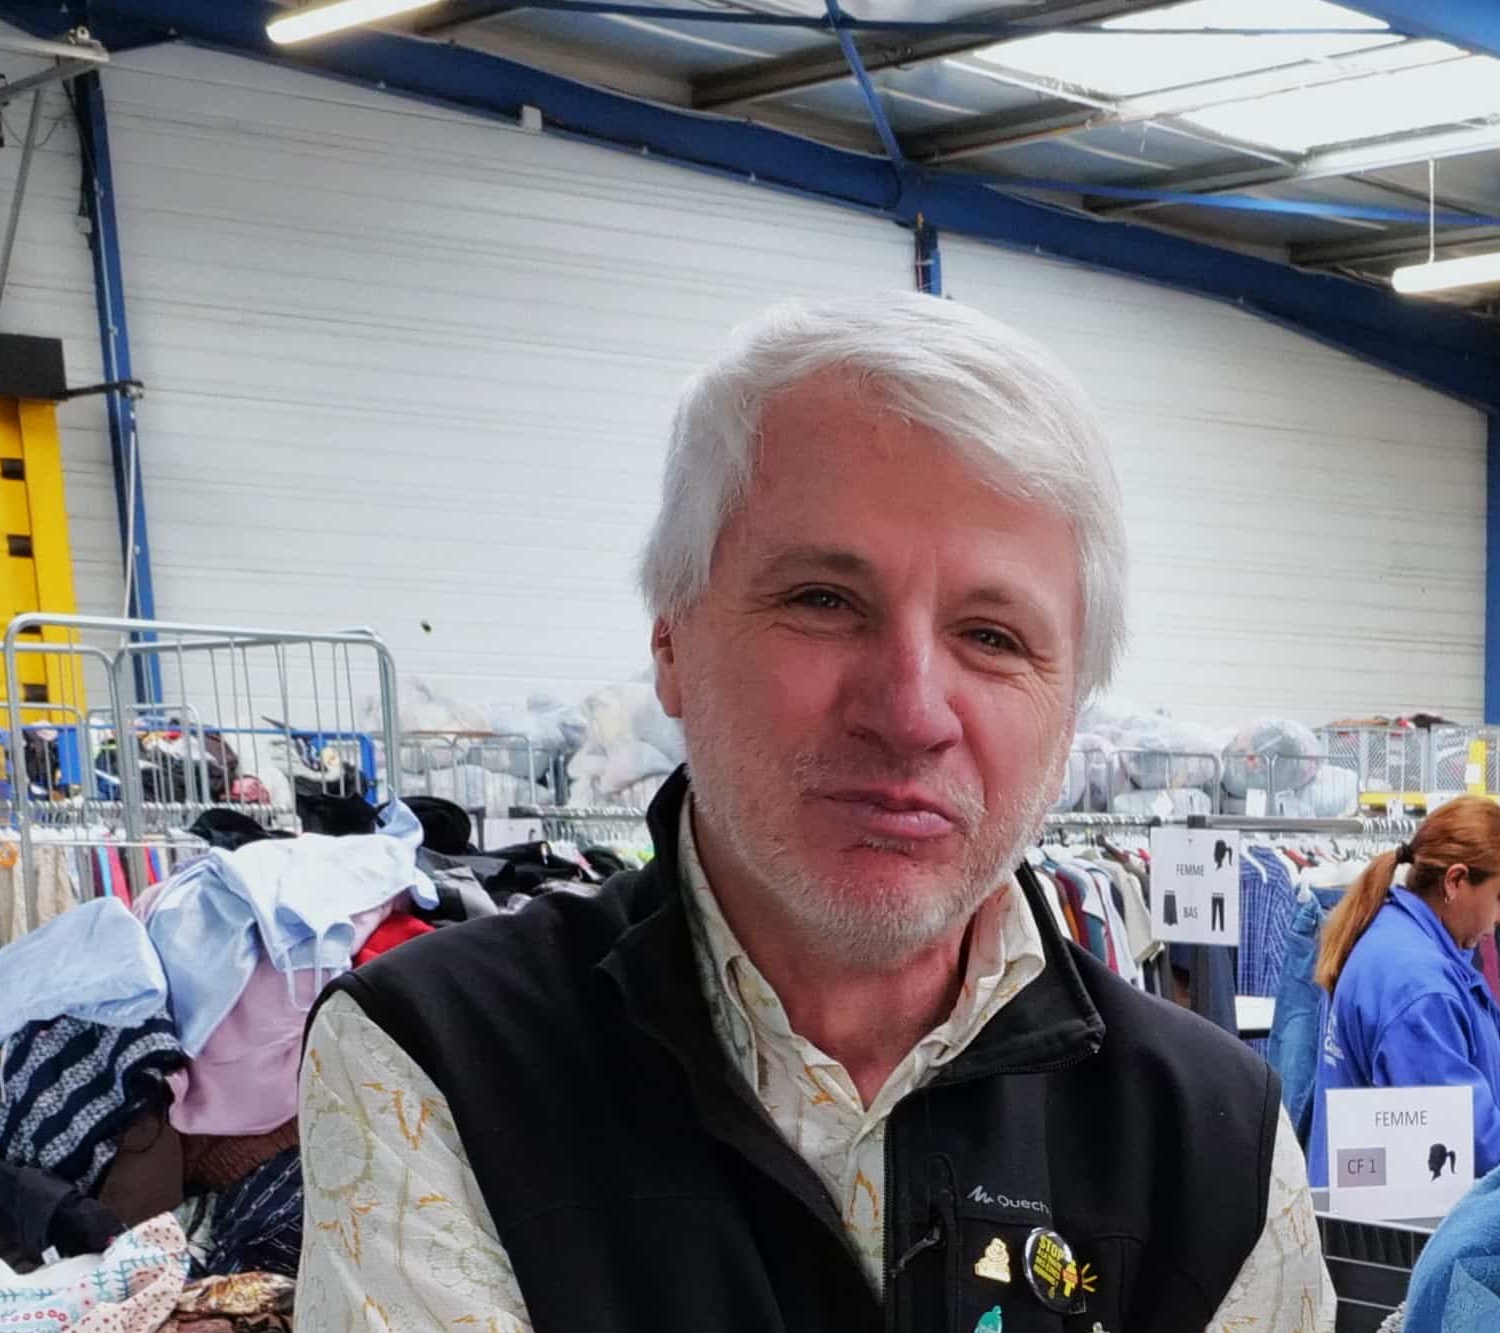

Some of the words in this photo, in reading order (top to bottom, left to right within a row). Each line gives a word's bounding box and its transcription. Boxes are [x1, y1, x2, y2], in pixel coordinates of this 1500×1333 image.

[1175, 863, 1205, 877] FEMME
[1183, 906, 1198, 919] BAS
[1375, 1110, 1428, 1127] FEMME
[1347, 1159, 1365, 1175] CF
[1370, 1158, 1376, 1174] 1
